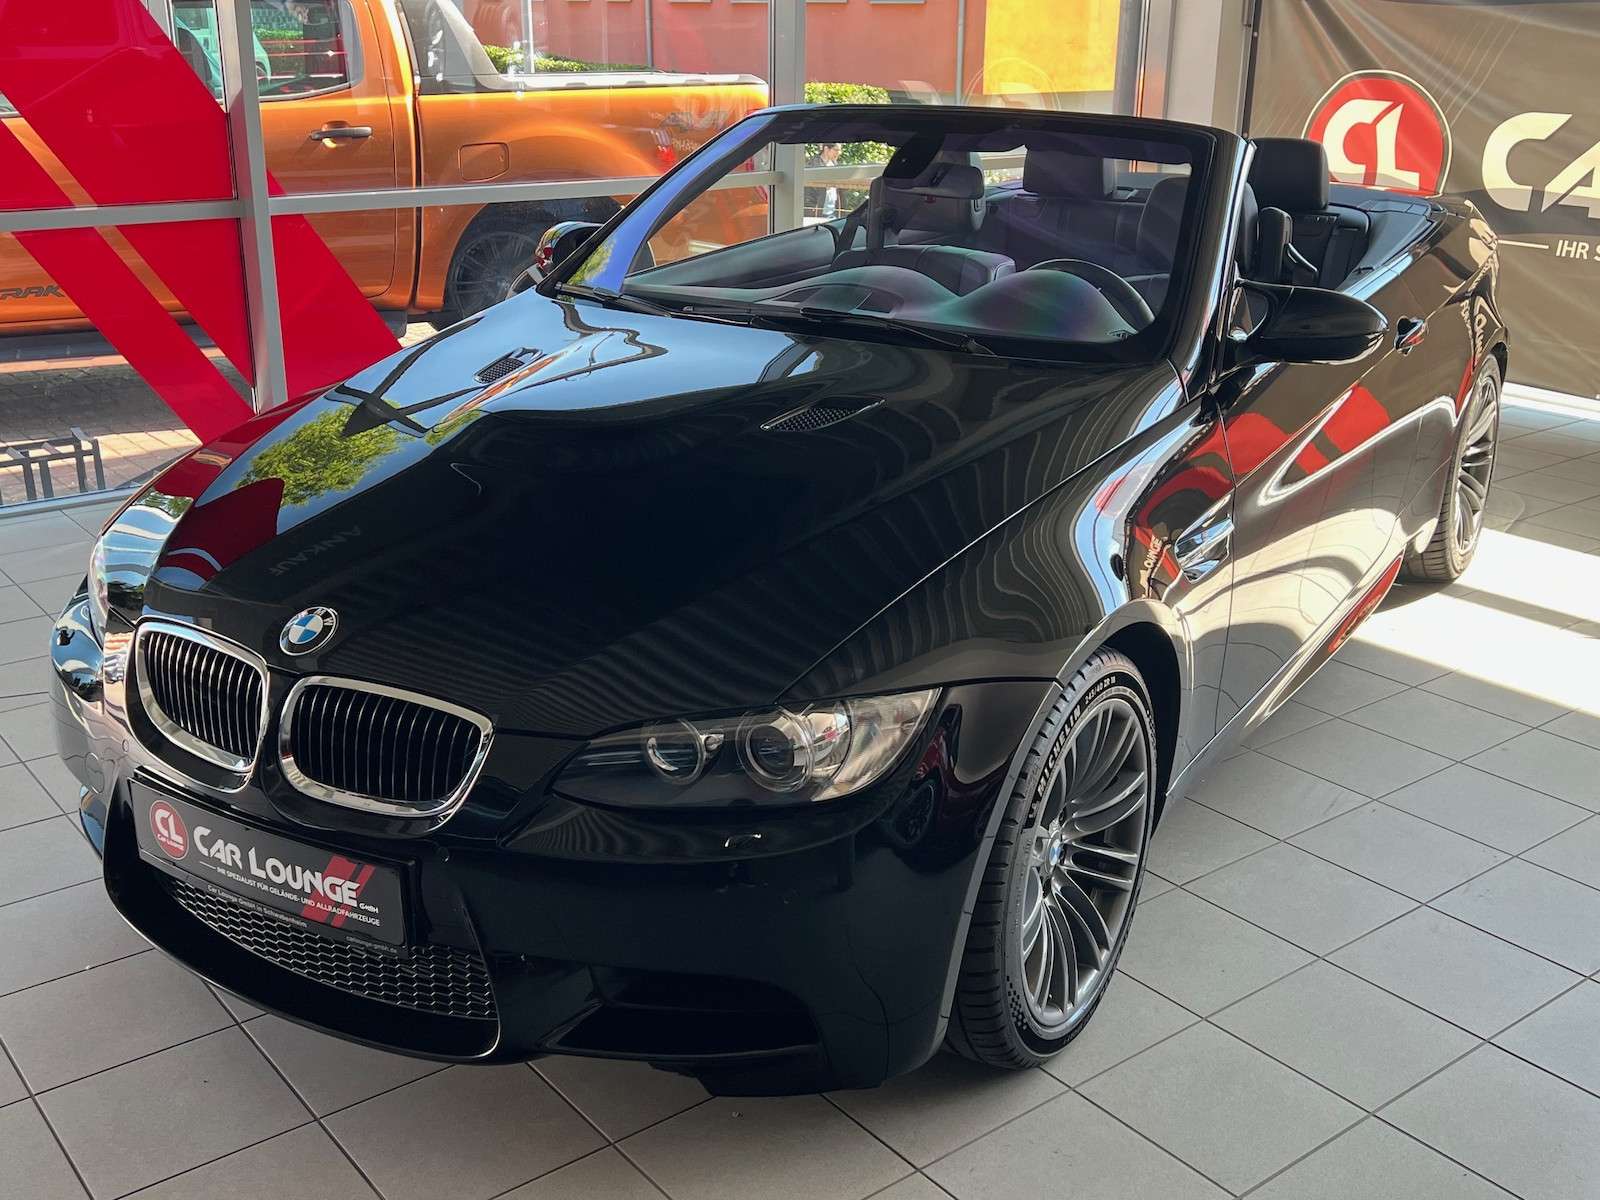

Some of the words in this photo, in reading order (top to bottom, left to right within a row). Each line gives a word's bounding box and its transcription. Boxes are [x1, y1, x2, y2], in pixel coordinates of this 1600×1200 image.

[1323, 98, 1420, 190] CL
[1555, 239, 1590, 260] IHR
[1037, 704, 1081, 797] MICHELIN
[155, 808, 184, 841] CL
[193, 825, 243, 869] CAR
[248, 846, 361, 907] LOUNGE
[227, 870, 256, 887] SPEZIALIST
[257, 881, 269, 892] FÜR
[269, 886, 301, 902] GELÄNDE-
[301, 897, 316, 907] UND
[316, 902, 381, 927] ALLRADFAHRZEUGE
